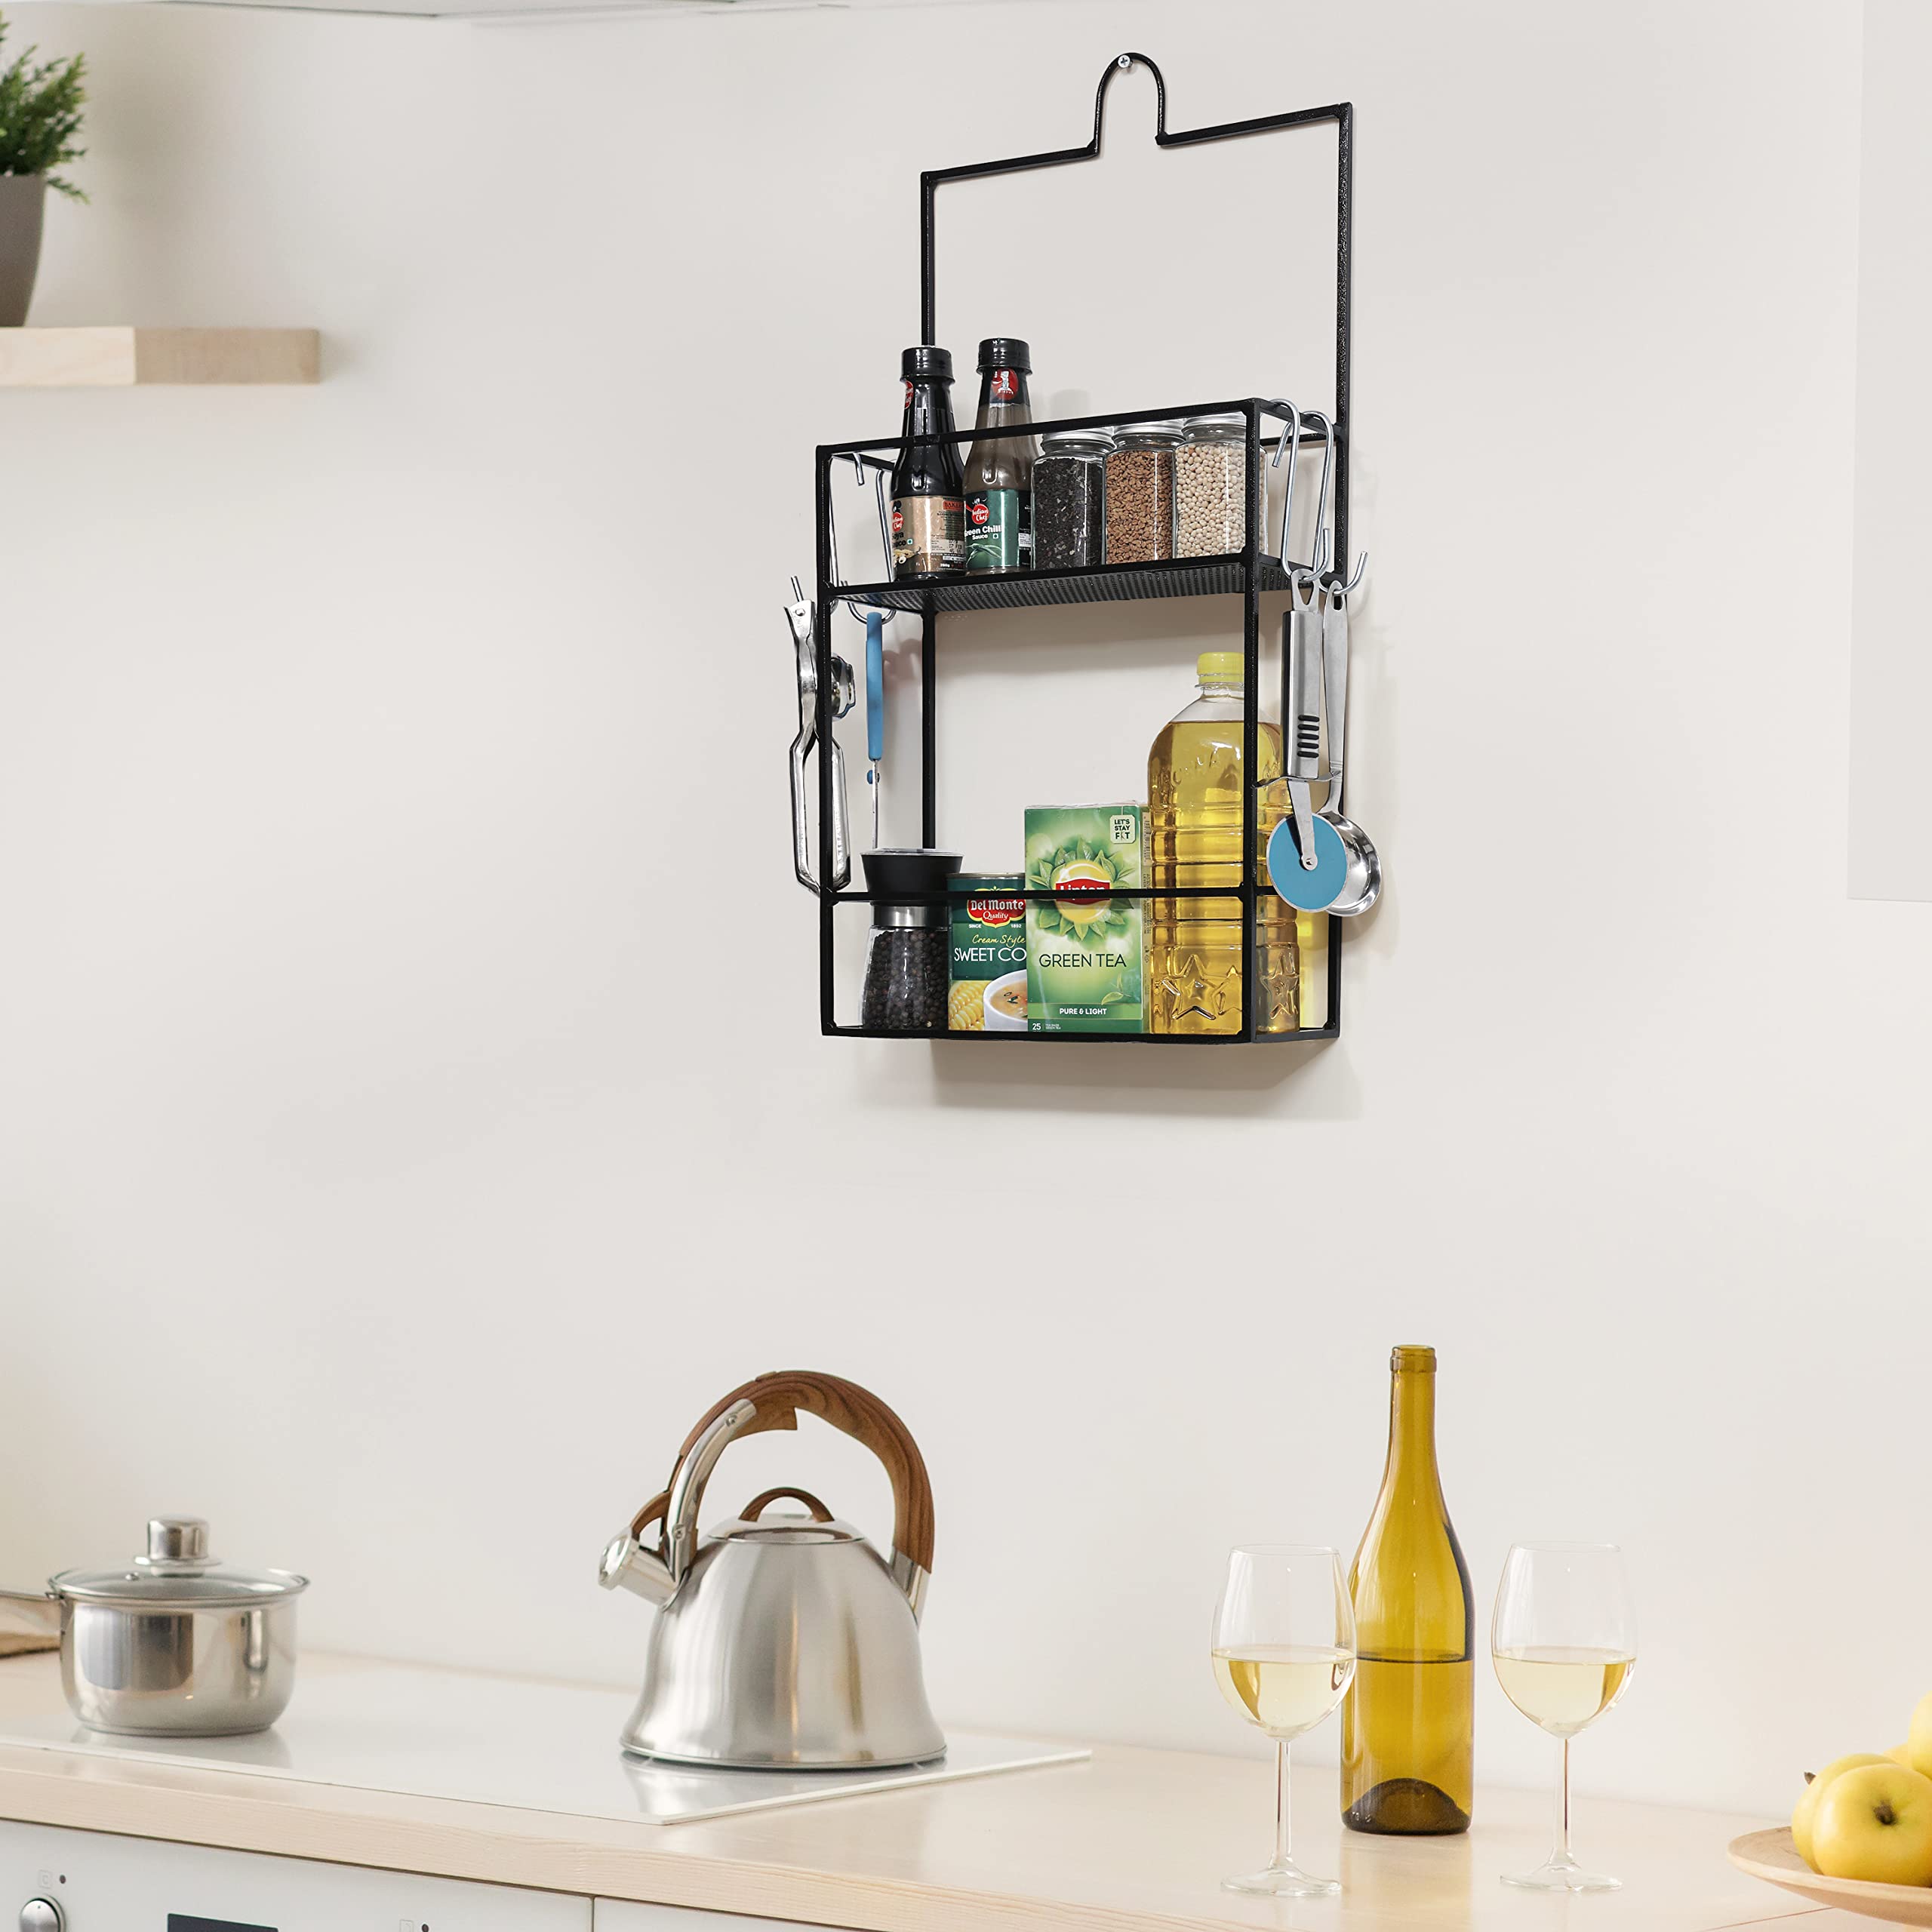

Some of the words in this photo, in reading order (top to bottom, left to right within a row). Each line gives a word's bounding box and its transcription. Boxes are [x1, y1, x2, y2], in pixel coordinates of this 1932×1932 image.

[976, 513, 988, 521] Chef
[971, 900, 986, 910] Del
[988, 899, 1024, 910] Monte
[983, 911, 1009, 921] Quality
[972, 934, 998, 944] Cream
[999, 934, 1026, 949] Style
[954, 947, 995, 961] SWEET
[1038, 953, 1092, 968] GREEN
[1095, 953, 1127, 968] TEA
[1032, 1023, 1041, 1031] 25
